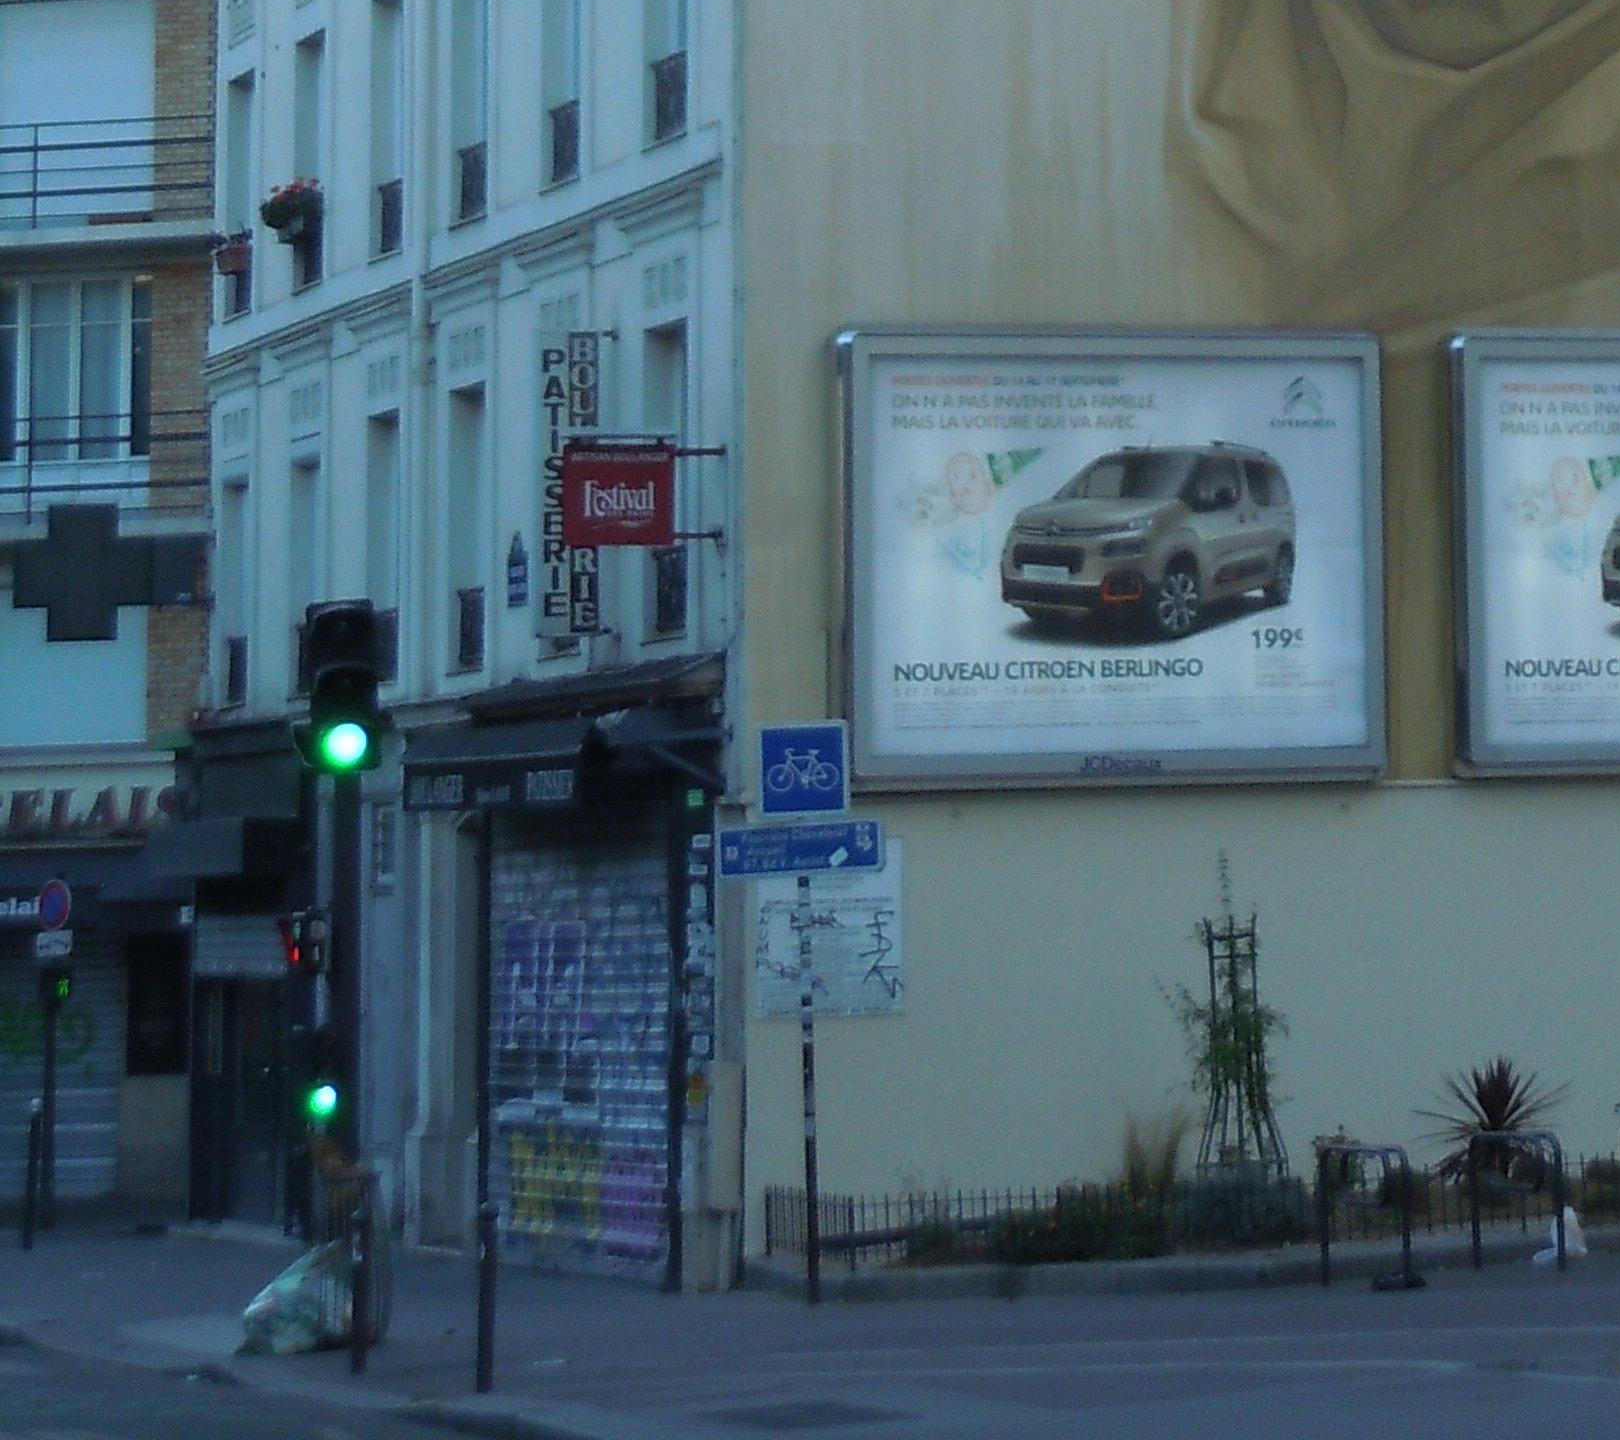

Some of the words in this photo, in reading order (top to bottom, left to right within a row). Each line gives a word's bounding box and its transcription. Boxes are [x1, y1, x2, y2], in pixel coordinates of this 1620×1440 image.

[542, 348, 566, 618] PATISSERIE
[568, 331, 599, 632] BOURIE
[583, 480, 655, 517] Festival
[893, 661, 1000, 682] NOUVEAU
[1100, 657, 1204, 678] BERLINGO
[1505, 658, 1601, 679] NOUVEAU
[0, 784, 200, 832] ELAIS
